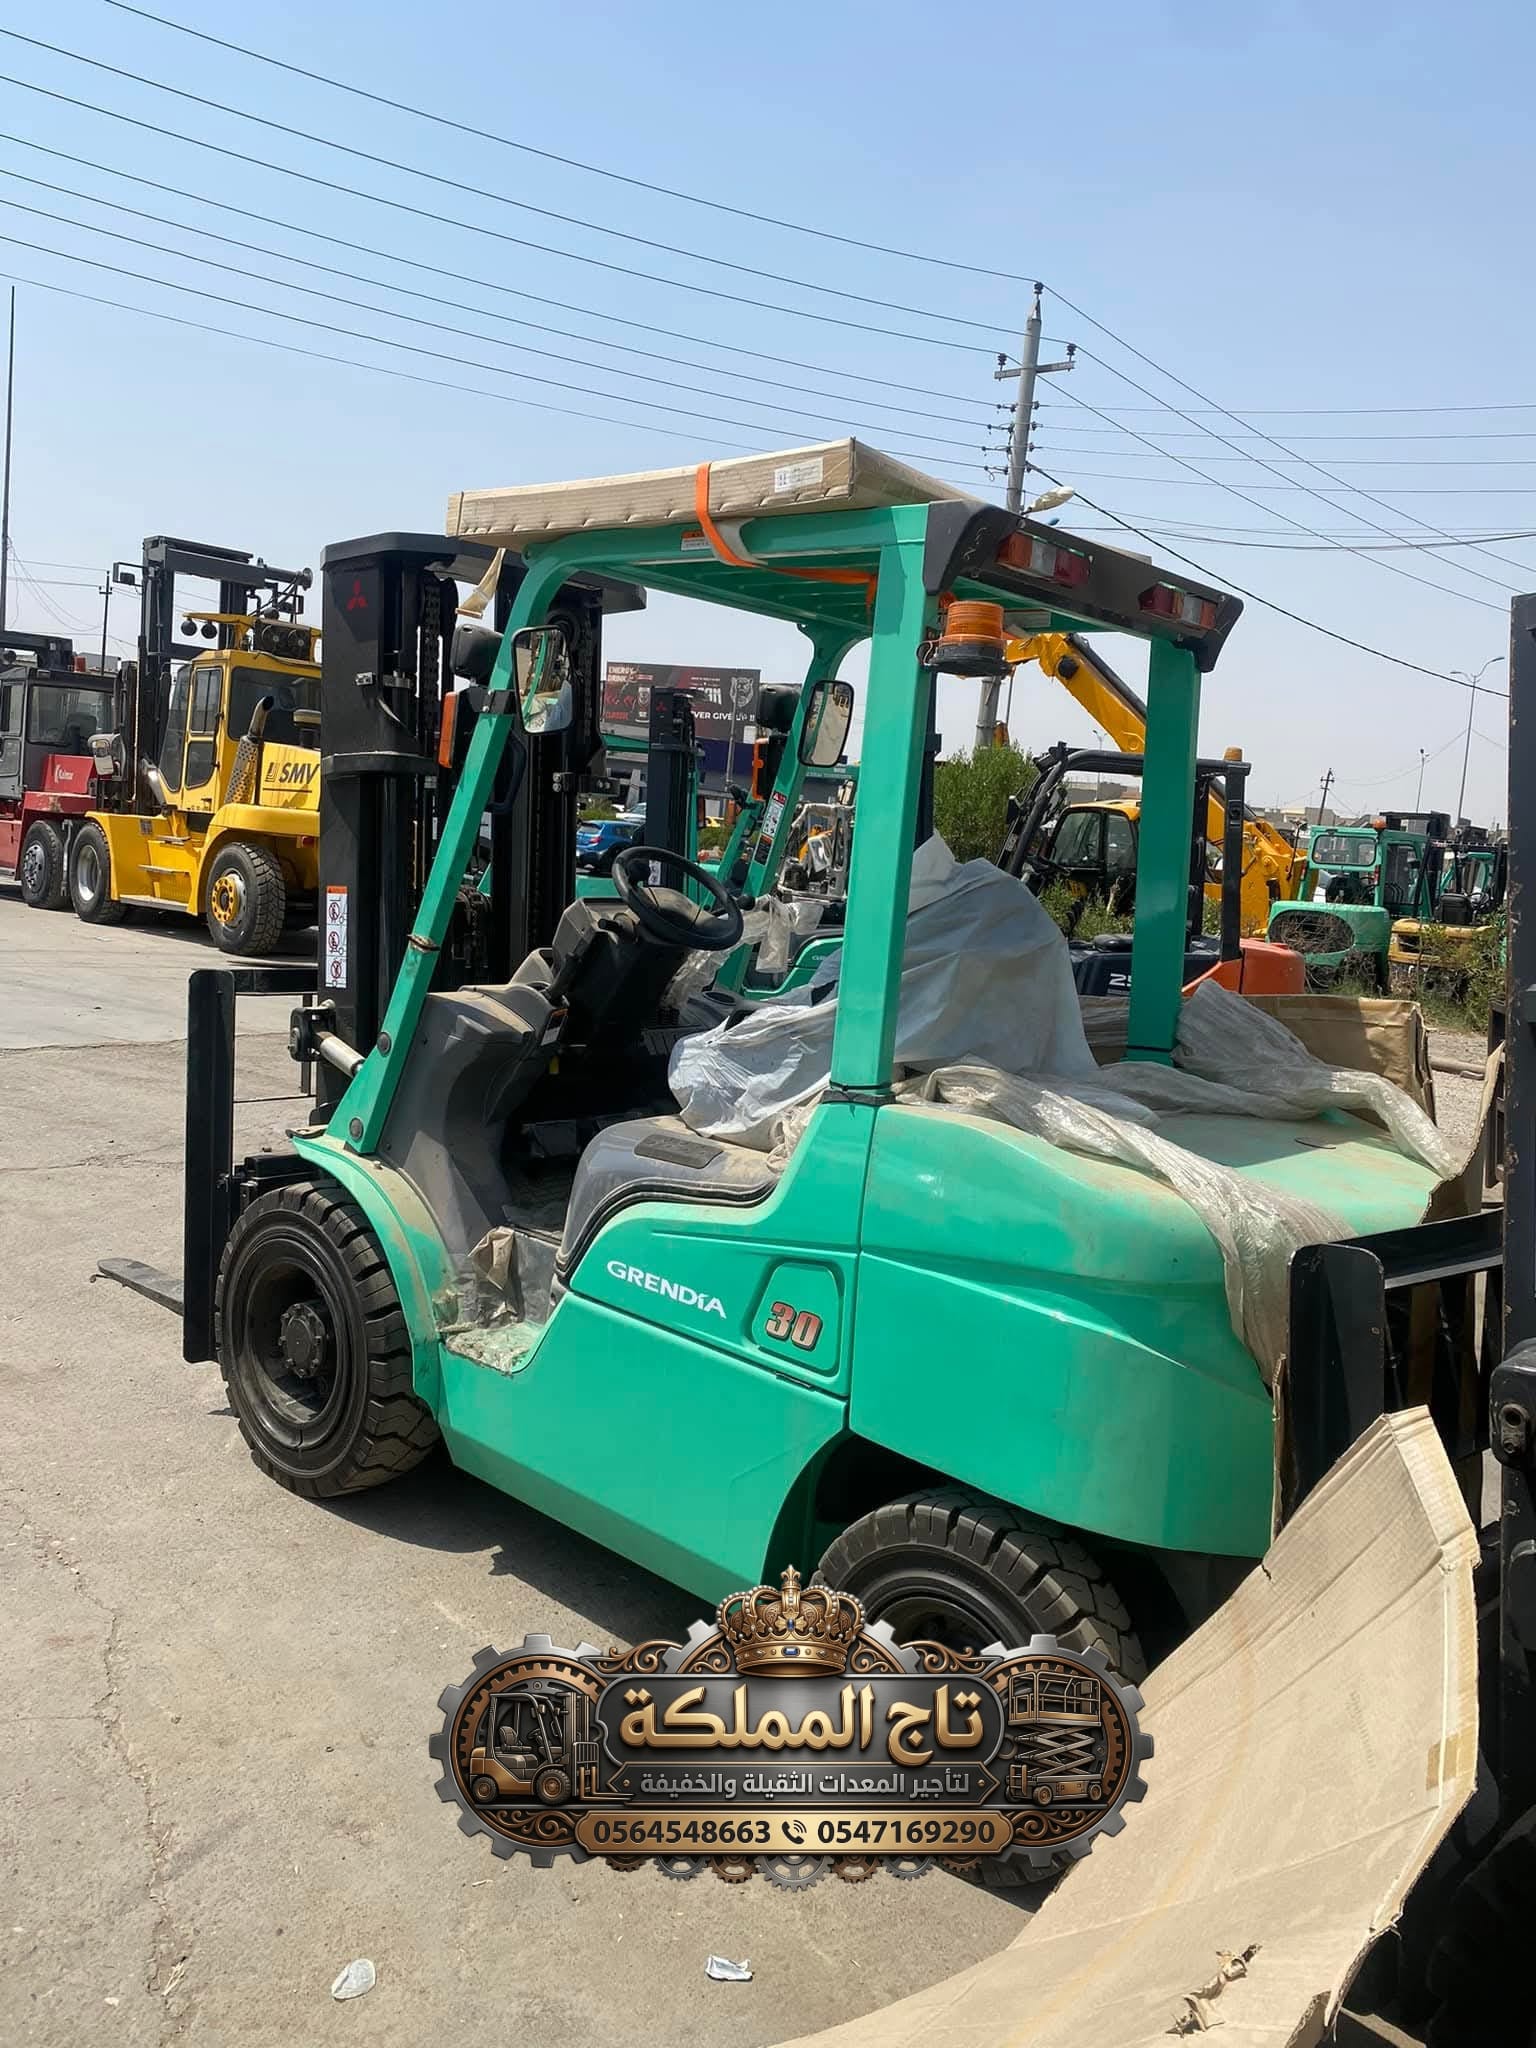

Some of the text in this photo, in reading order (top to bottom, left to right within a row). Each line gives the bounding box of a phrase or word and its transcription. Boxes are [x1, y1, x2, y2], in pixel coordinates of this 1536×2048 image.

[279, 762, 320, 784] SMV
[1109, 973, 1131, 987] 2
[765, 1301, 823, 1351] 30
